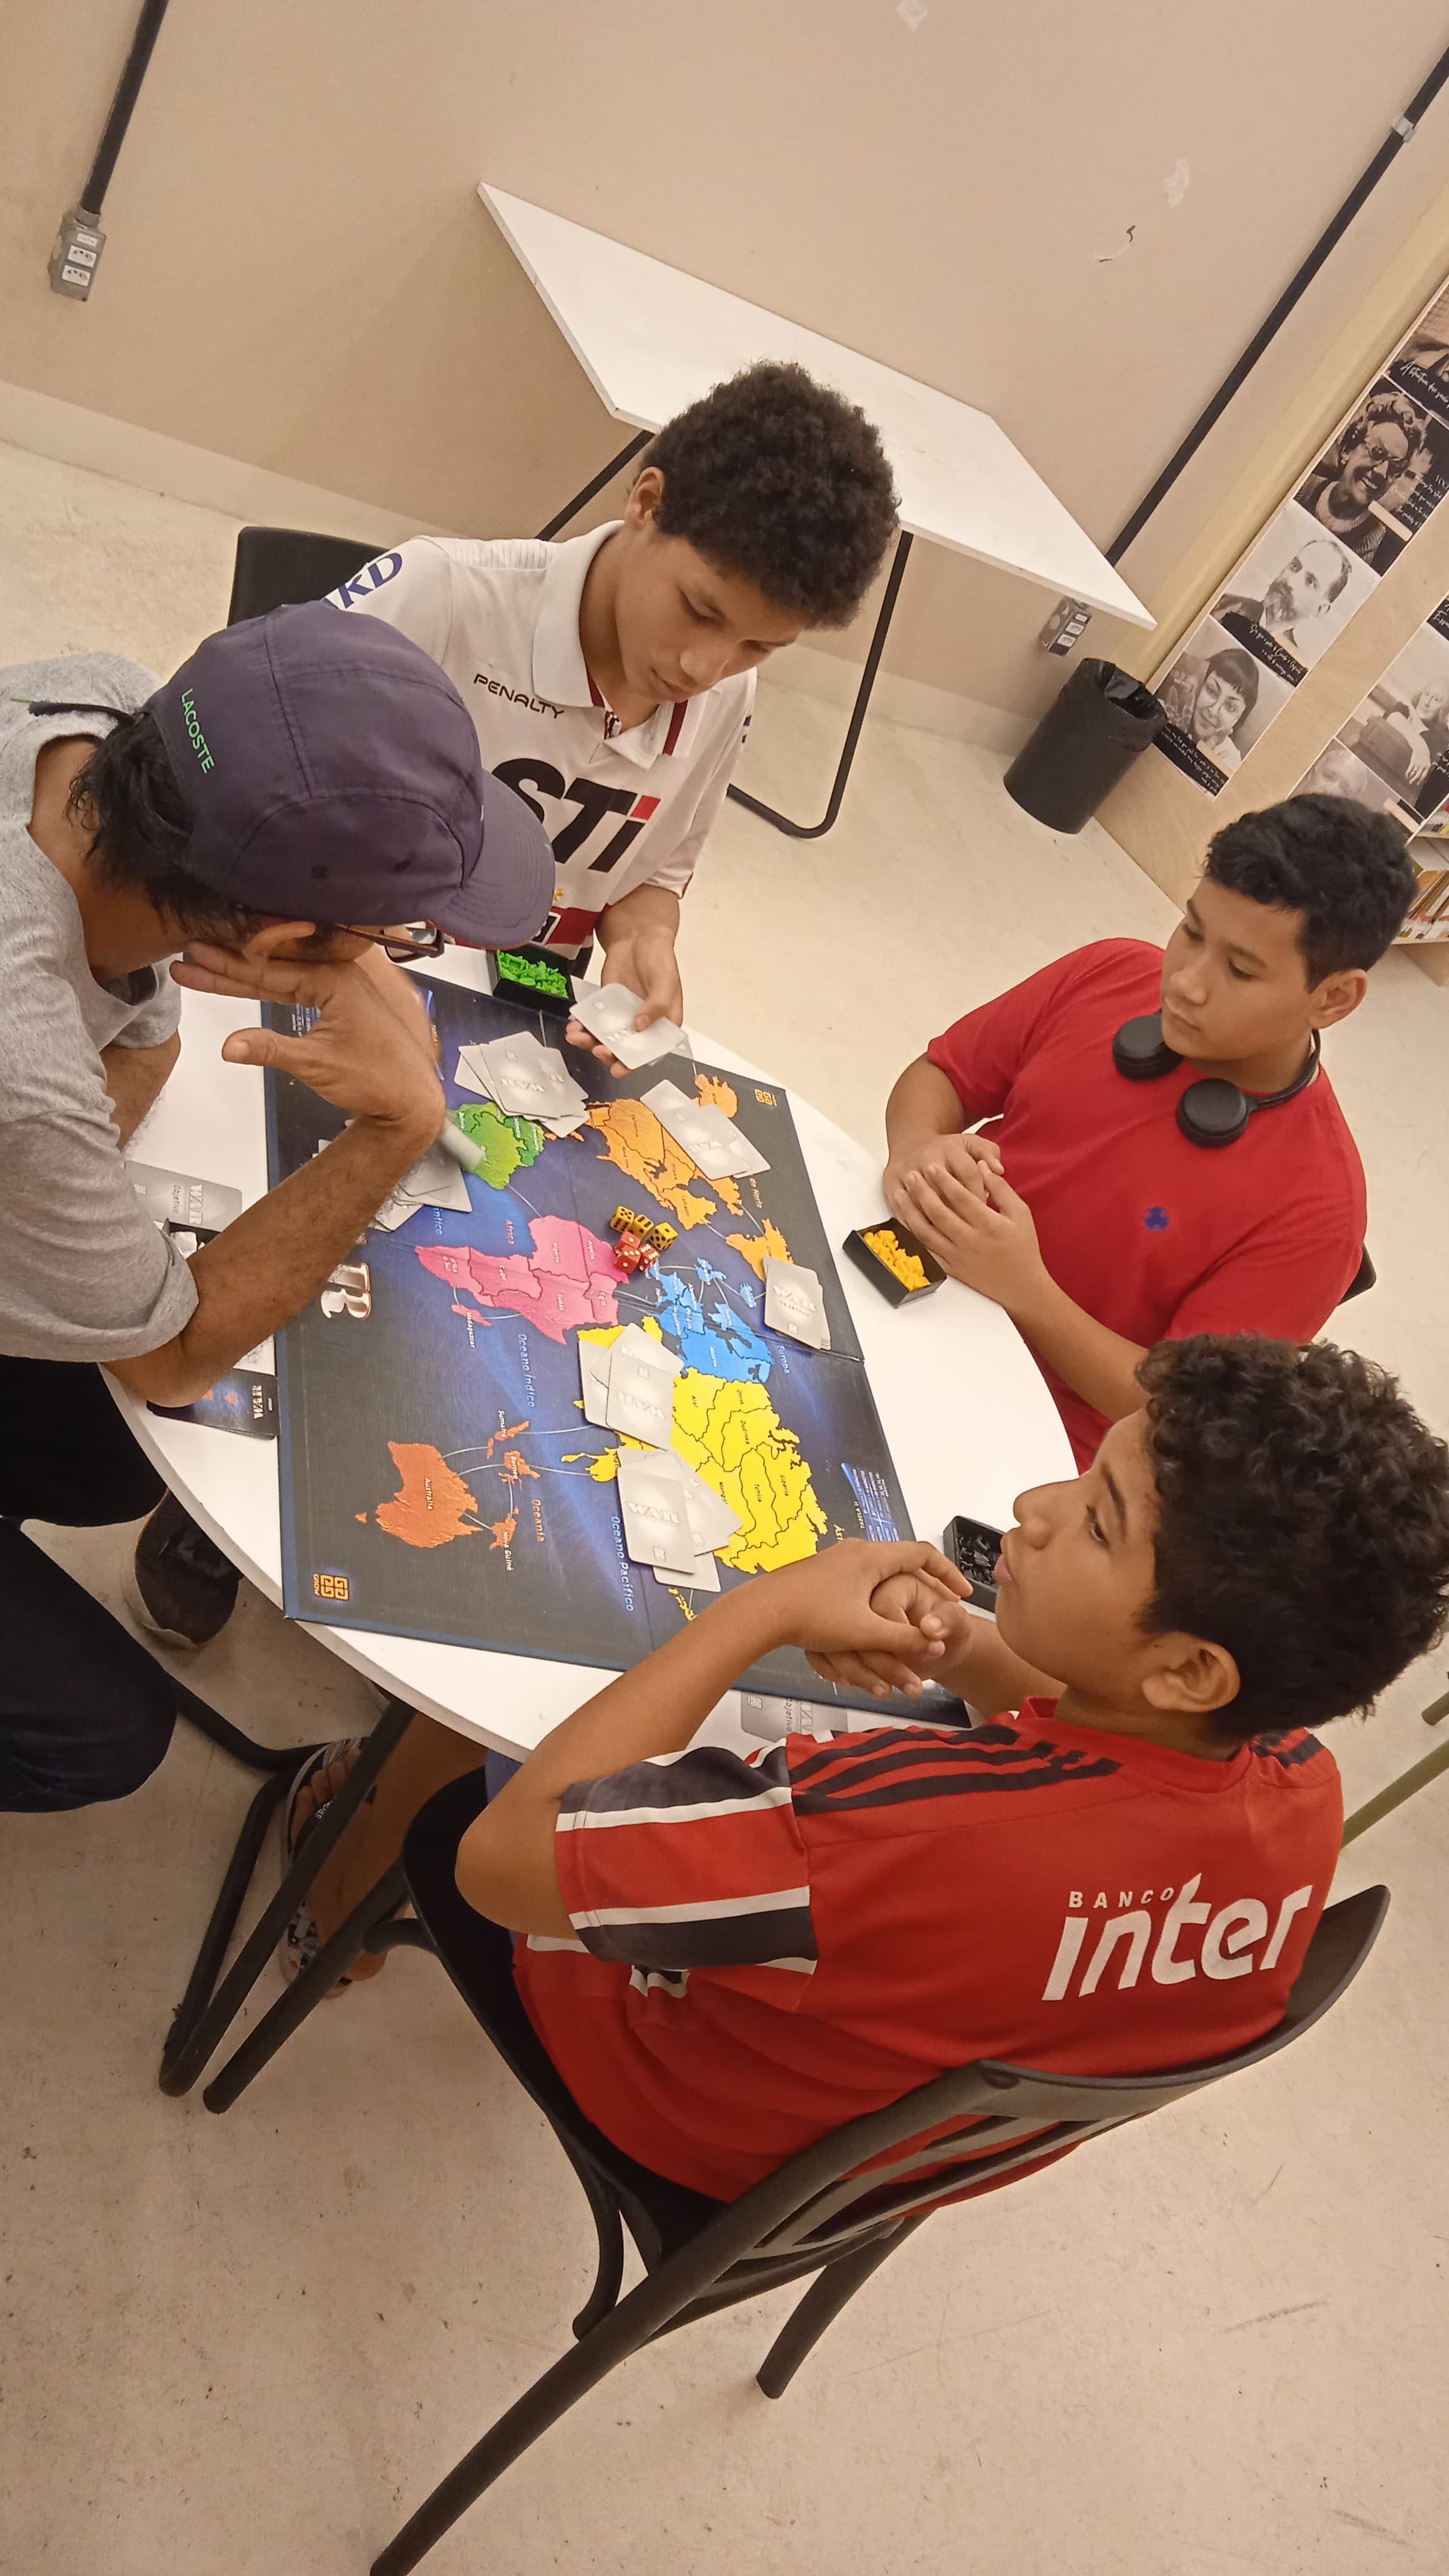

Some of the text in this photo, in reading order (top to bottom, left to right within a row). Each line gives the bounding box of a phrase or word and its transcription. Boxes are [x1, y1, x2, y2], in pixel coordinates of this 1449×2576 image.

[320, 552, 403, 611] KD
[474, 673, 565, 719] PENALTY
[181, 687, 215, 774] LACOSTE
[172, 1184, 181, 1214] Objetivo
[189, 1184, 203, 1225] WAR
[466, 1312, 475, 1348] Madagascar
[518, 1333, 531, 1372] Oceano
[777, 1345, 790, 1374] Europa
[252, 1385, 263, 1419] WAR
[497, 1409, 507, 1438] Sumatra
[531, 1499, 545, 1543] Oceania
[627, 1501, 682, 1526] WAR
[502, 1531, 514, 1572] Nova Guiné
[611, 1516, 635, 1612] Oceano Pacífico
[313, 1573, 321, 1597] GROW
[1069, 1887, 1175, 1909] BANCO
[1041, 1872, 1313, 2001] inter
